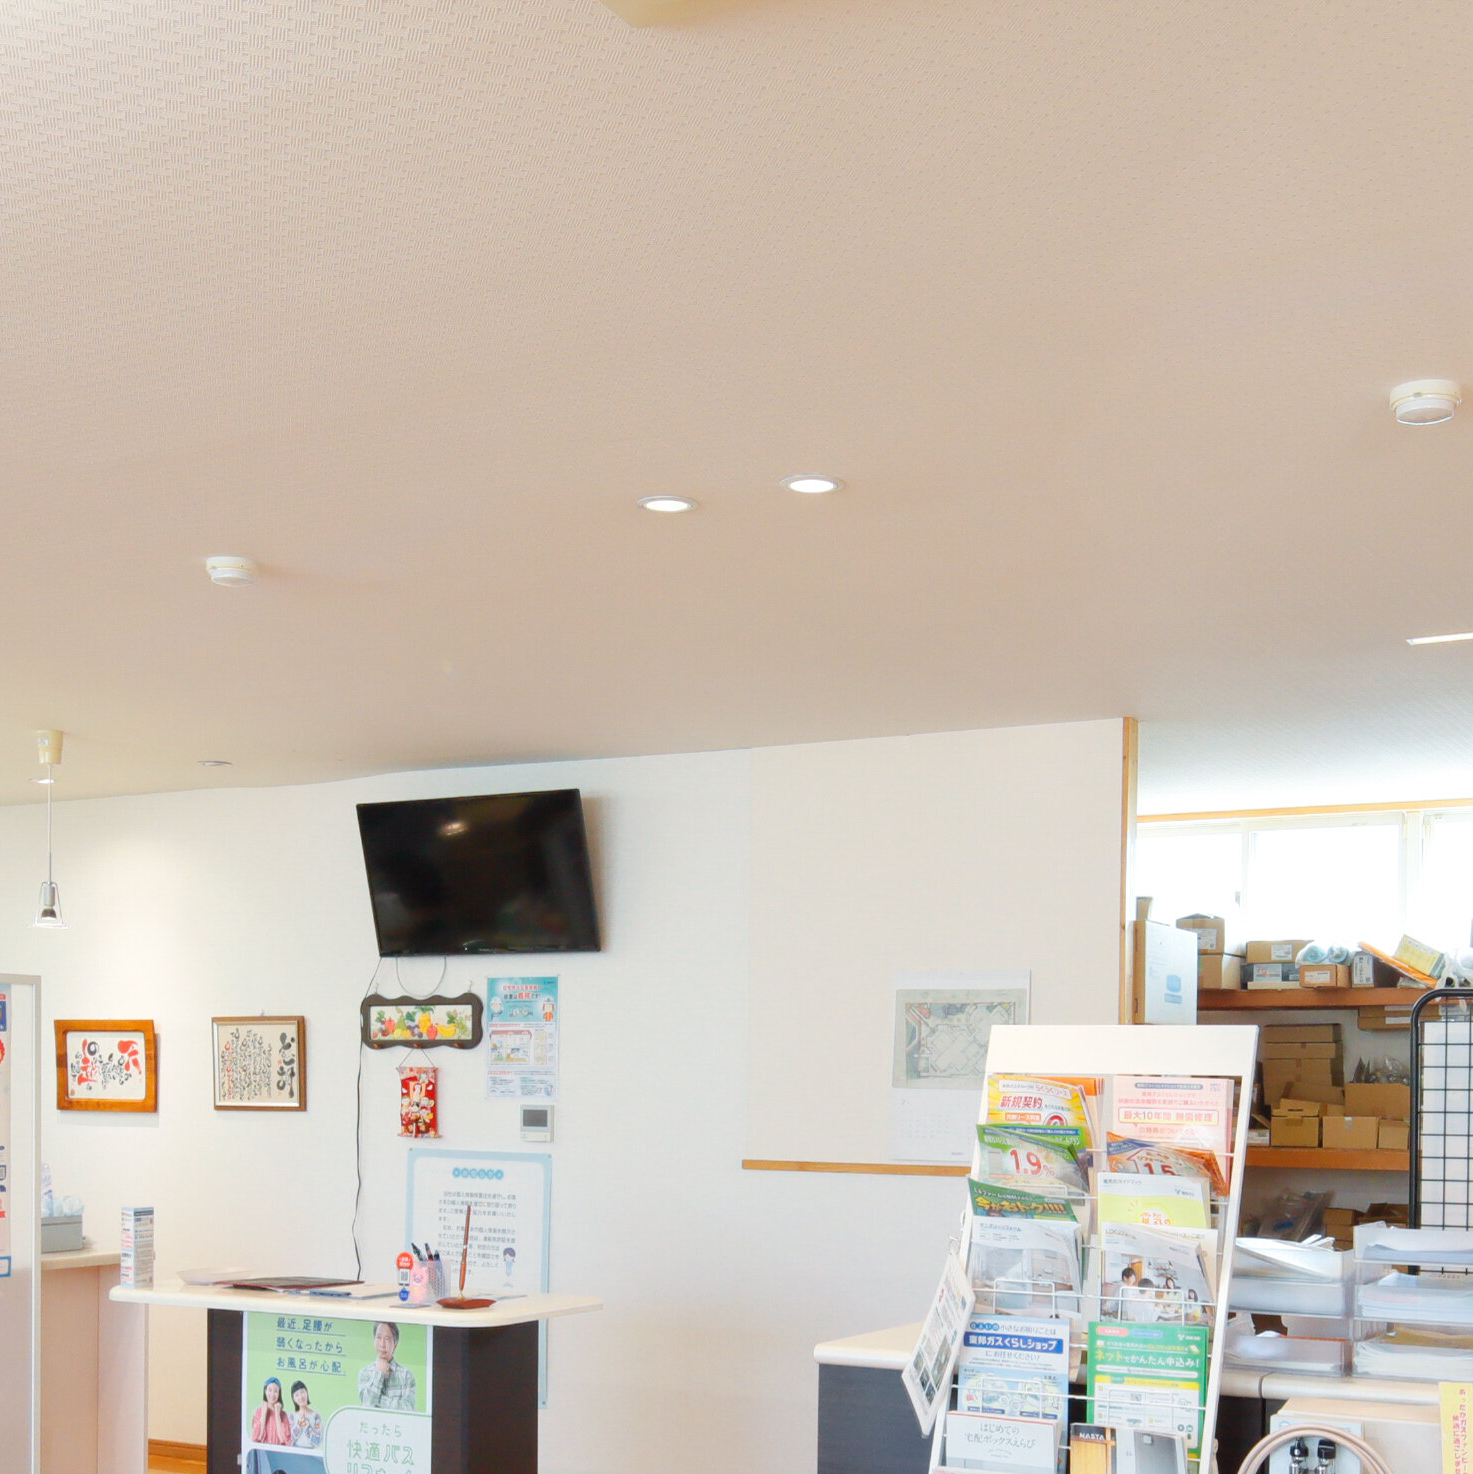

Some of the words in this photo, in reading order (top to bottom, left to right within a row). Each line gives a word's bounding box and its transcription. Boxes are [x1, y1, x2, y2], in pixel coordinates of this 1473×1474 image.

[999, 1095, 1043, 1109] 新規契約
[277, 1336, 344, 1354] 弱くなったから
[968, 1334, 1058, 1351] 東邦ガスくらしショップ
[360, 1421, 402, 1438] だったら
[1079, 1432, 1106, 1441] NASTA
[964, 1431, 1037, 1450] 宅配ボックスえらび
[346, 1438, 415, 1466] 快適バス
